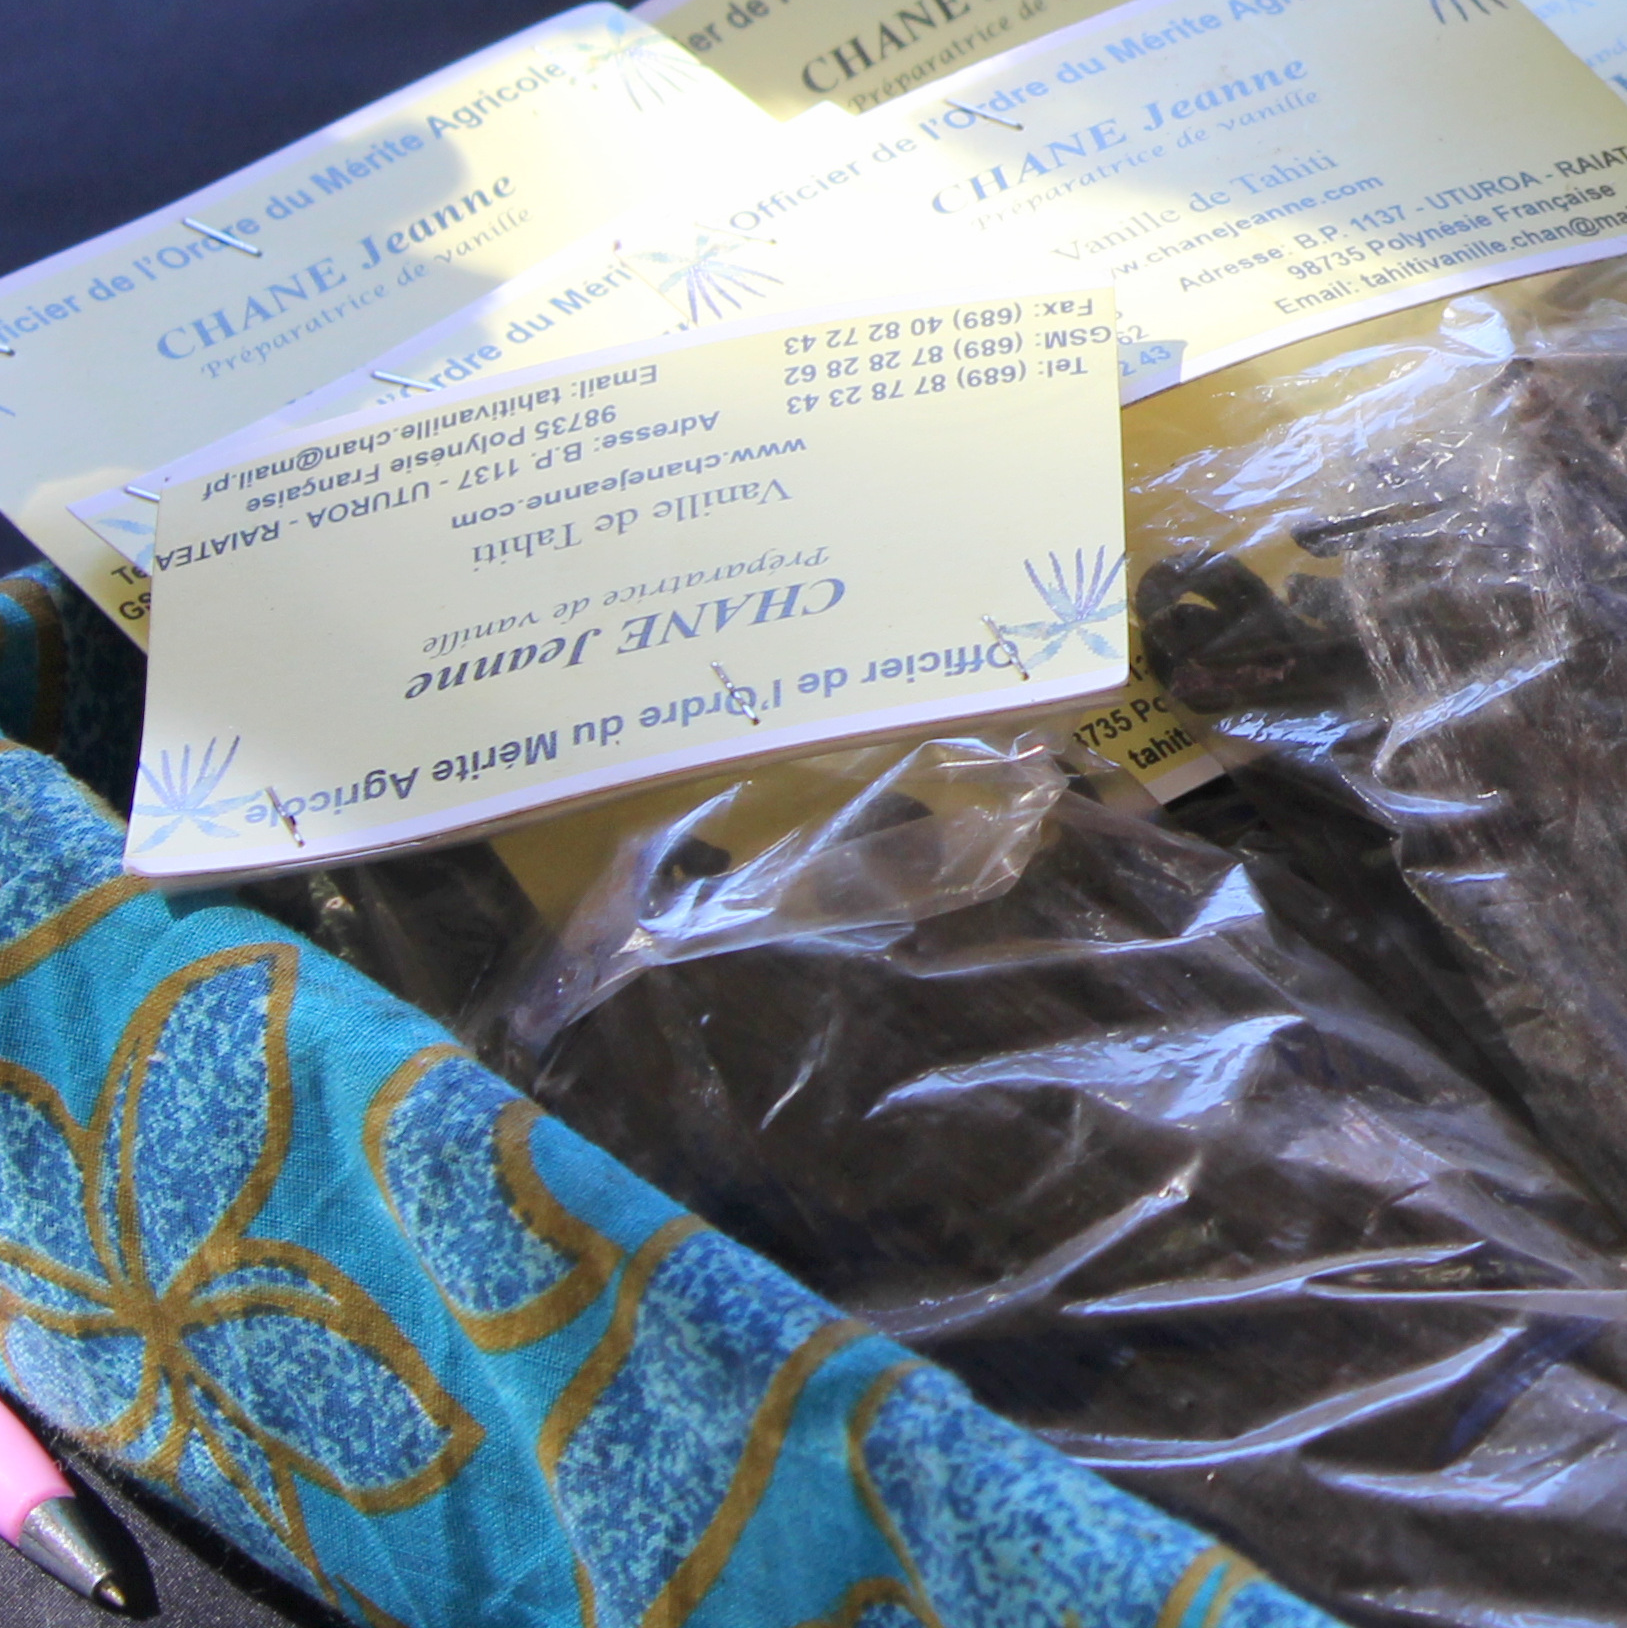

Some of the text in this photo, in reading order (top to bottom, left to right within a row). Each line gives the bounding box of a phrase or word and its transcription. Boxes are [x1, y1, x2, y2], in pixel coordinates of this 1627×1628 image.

[845, 17, 1013, 114] Préparatrice
[1175, 129, 1206, 148] de
[1217, 90, 1318, 132] vanille
[727, 161, 864, 231] Officier
[870, 138, 917, 162] de
[919, 80, 1049, 140] l'Ordre
[1055, 57, 1106, 84] du
[1103, 13, 1223, 64] Mérite
[928, 58, 1307, 214] CHANE Jeanne
[86, 63, 562, 302] de l'Ordre du Mérite Agricole
[1052, 150, 1339, 261] Vanille de Tahiti
[1175, 245, 1290, 291] Adresse:
[1293, 225, 1347, 249] B.P.
[1349, 205, 1407, 232] 1137
[1425, 171, 1541, 210] UTUROA
[1287, 183, 1617, 279] 98735 Polynésie Française
[155, 177, 513, 360] CHANE Jeanne
[200, 210, 531, 380] Préparatrice de vanille
[1273, 279, 1360, 314] Email:
[505, 305, 557, 346] du
[784, 295, 1093, 356] Fax: (689) 40 82 72 43
[784, 321, 1112, 386] GSM: (689) 87 28 28 62
[1137, 344, 1173, 365] 43
[202, 364, 657, 500] Email: tahitivanille.chan@mail.pf
[786, 354, 1087, 415] Tel: (689) 87 78 23 43
[155, 411, 719, 571] Adresse: B.P. 1137 UTUROA RAIATEA
[246, 404, 616, 513] 98735 Polynésie Française
[451, 438, 806, 529] www.chanejeanne.com
[473, 478, 790, 571] Vanille de Tahiti
[404, 578, 845, 699] CHANE Jeanne
[422, 545, 828, 659] Préparatrice de vanille
[246, 632, 1017, 826] Officier de l'Ordre du Mérite Agricole
